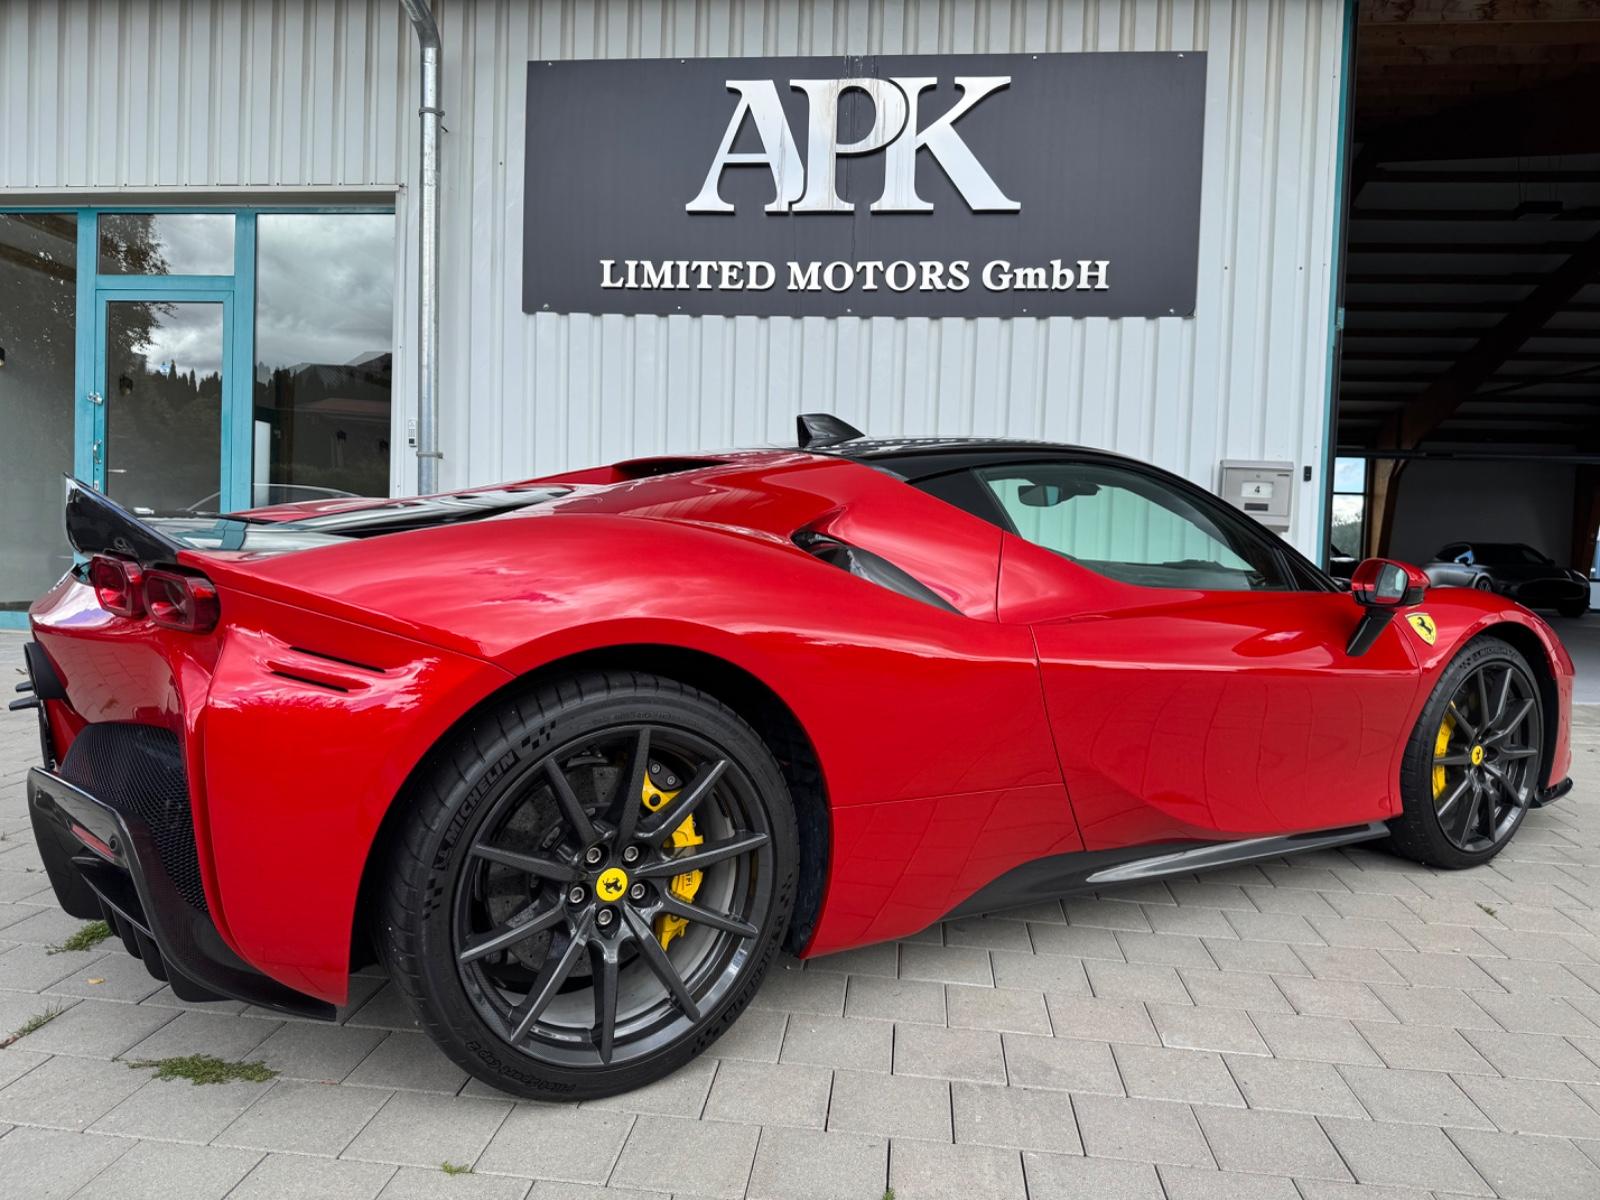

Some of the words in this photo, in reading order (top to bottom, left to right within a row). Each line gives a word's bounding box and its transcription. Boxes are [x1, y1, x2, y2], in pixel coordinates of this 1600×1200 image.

[685, 76, 1022, 214] APK
[599, 259, 776, 291] LIMITED
[786, 260, 970, 292] MOTORS
[982, 259, 1110, 291] GmbH
[1254, 485, 1260, 493] 4
[443, 749, 518, 847] MICHELIN
